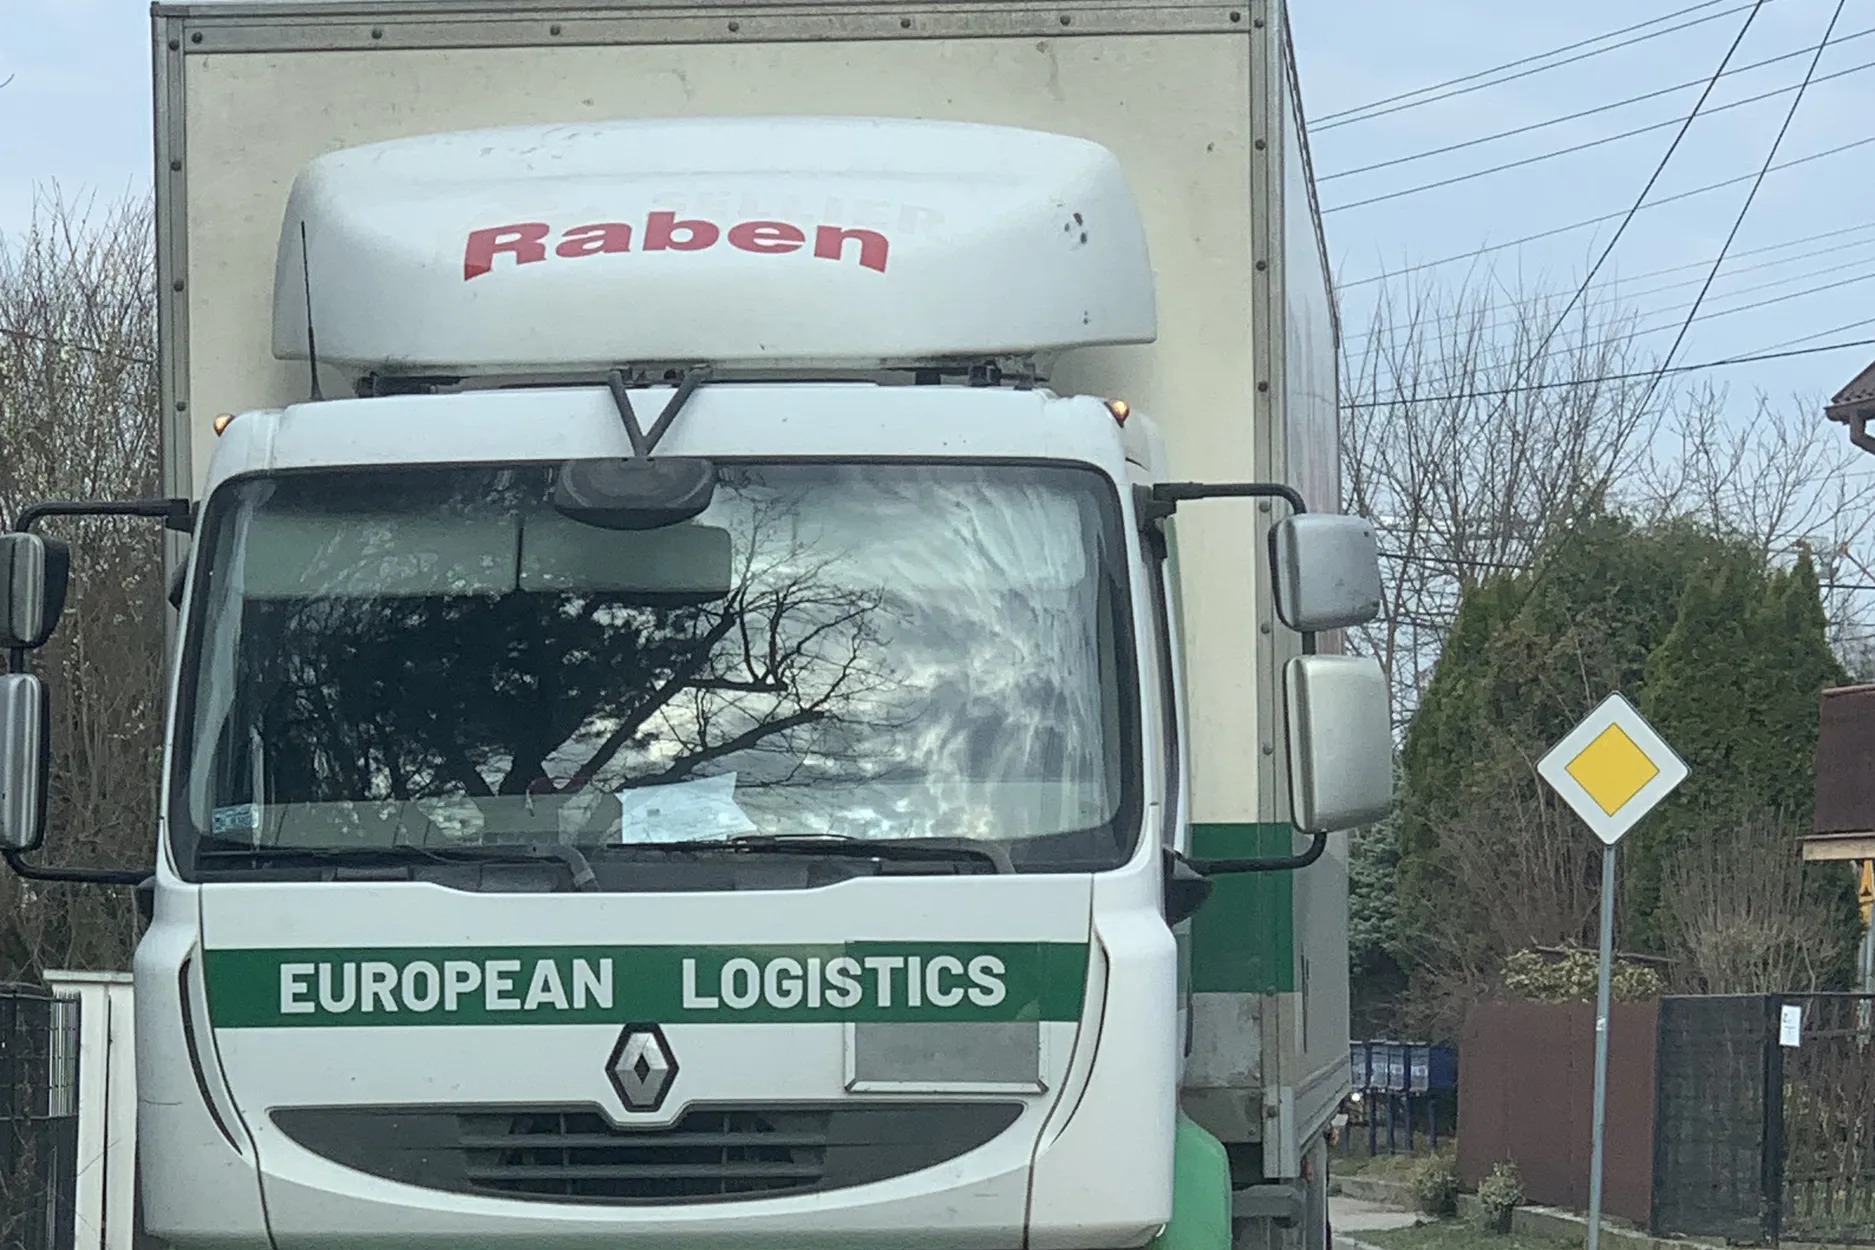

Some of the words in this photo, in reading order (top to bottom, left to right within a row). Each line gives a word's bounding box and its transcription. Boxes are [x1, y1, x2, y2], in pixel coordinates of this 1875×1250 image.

[464, 210, 890, 281] Raben
[279, 958, 614, 1014] EUROPEAN
[682, 955, 1007, 1009] LOGISTICS
